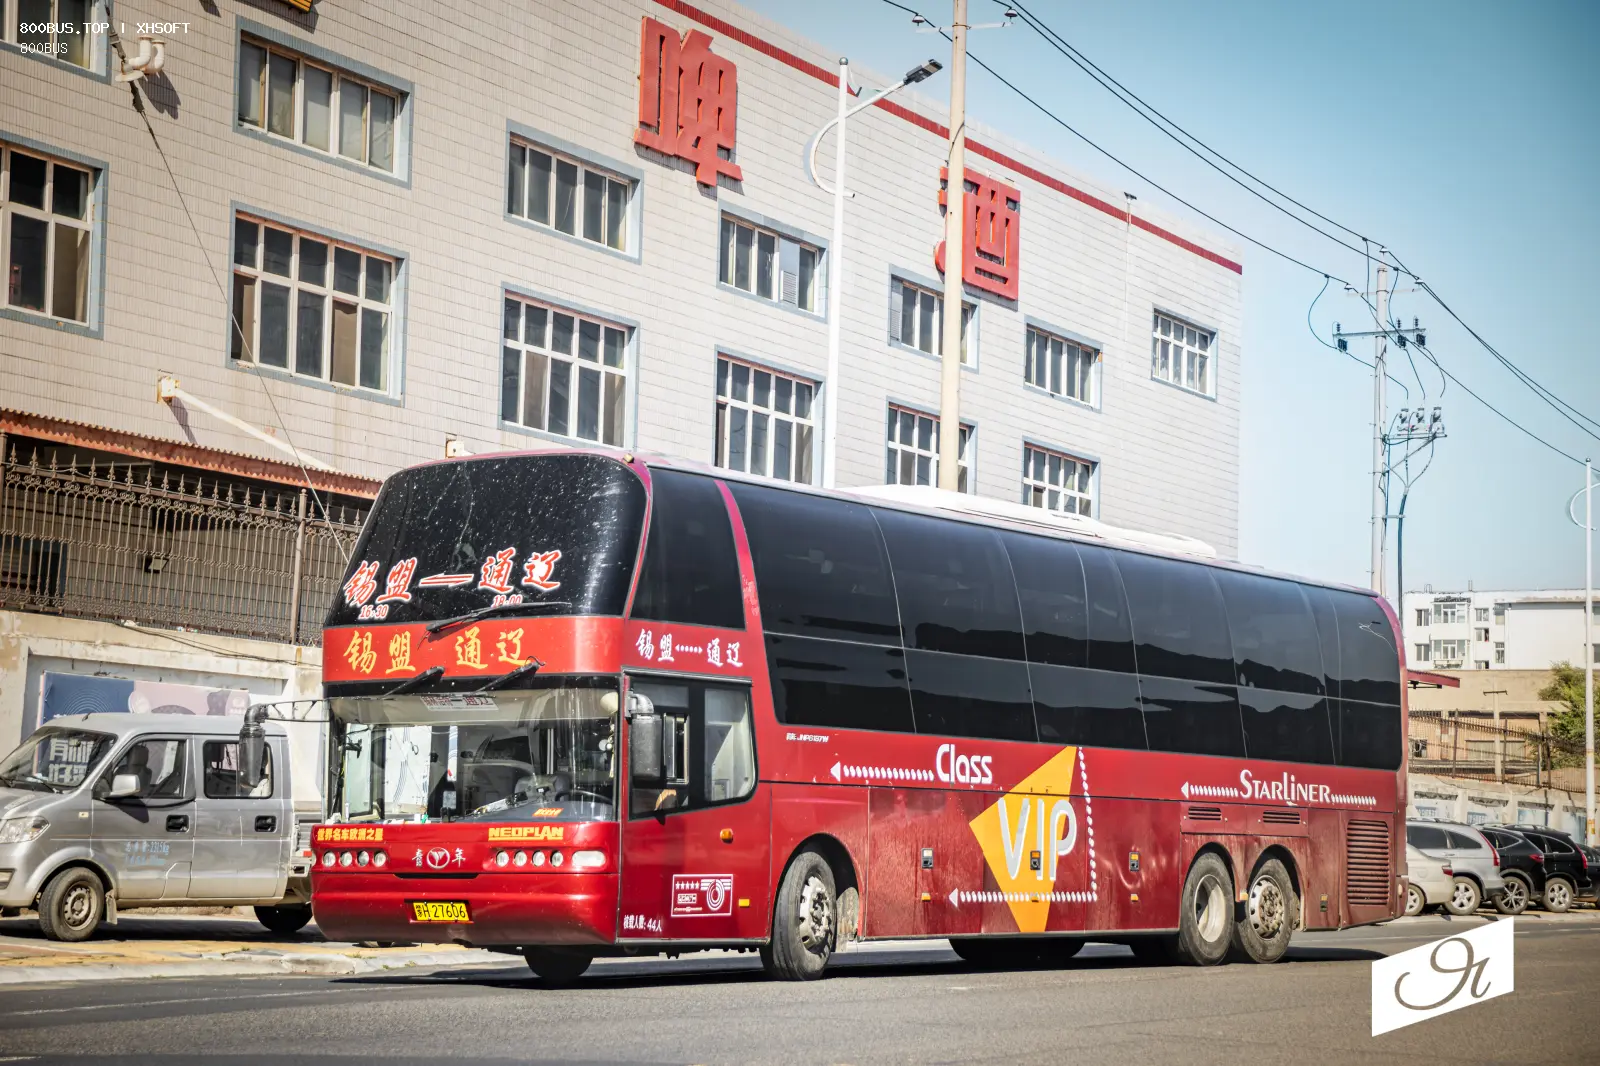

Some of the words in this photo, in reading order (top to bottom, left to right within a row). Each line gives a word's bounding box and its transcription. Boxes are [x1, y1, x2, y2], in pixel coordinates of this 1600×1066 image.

[343, 556, 418, 608] 锡盟
[478, 547, 562, 594] 通辽
[358, 604, 389, 620] 16:30
[343, 631, 416, 675] 锡盟
[455, 626, 532, 670] 通辽
[635, 628, 674, 662] 锡盟
[707, 637, 743, 668] 通辽
[935, 743, 993, 785] Class
[488, 826, 564, 841] NEOPLAN
[997, 797, 1077, 881] VIP
